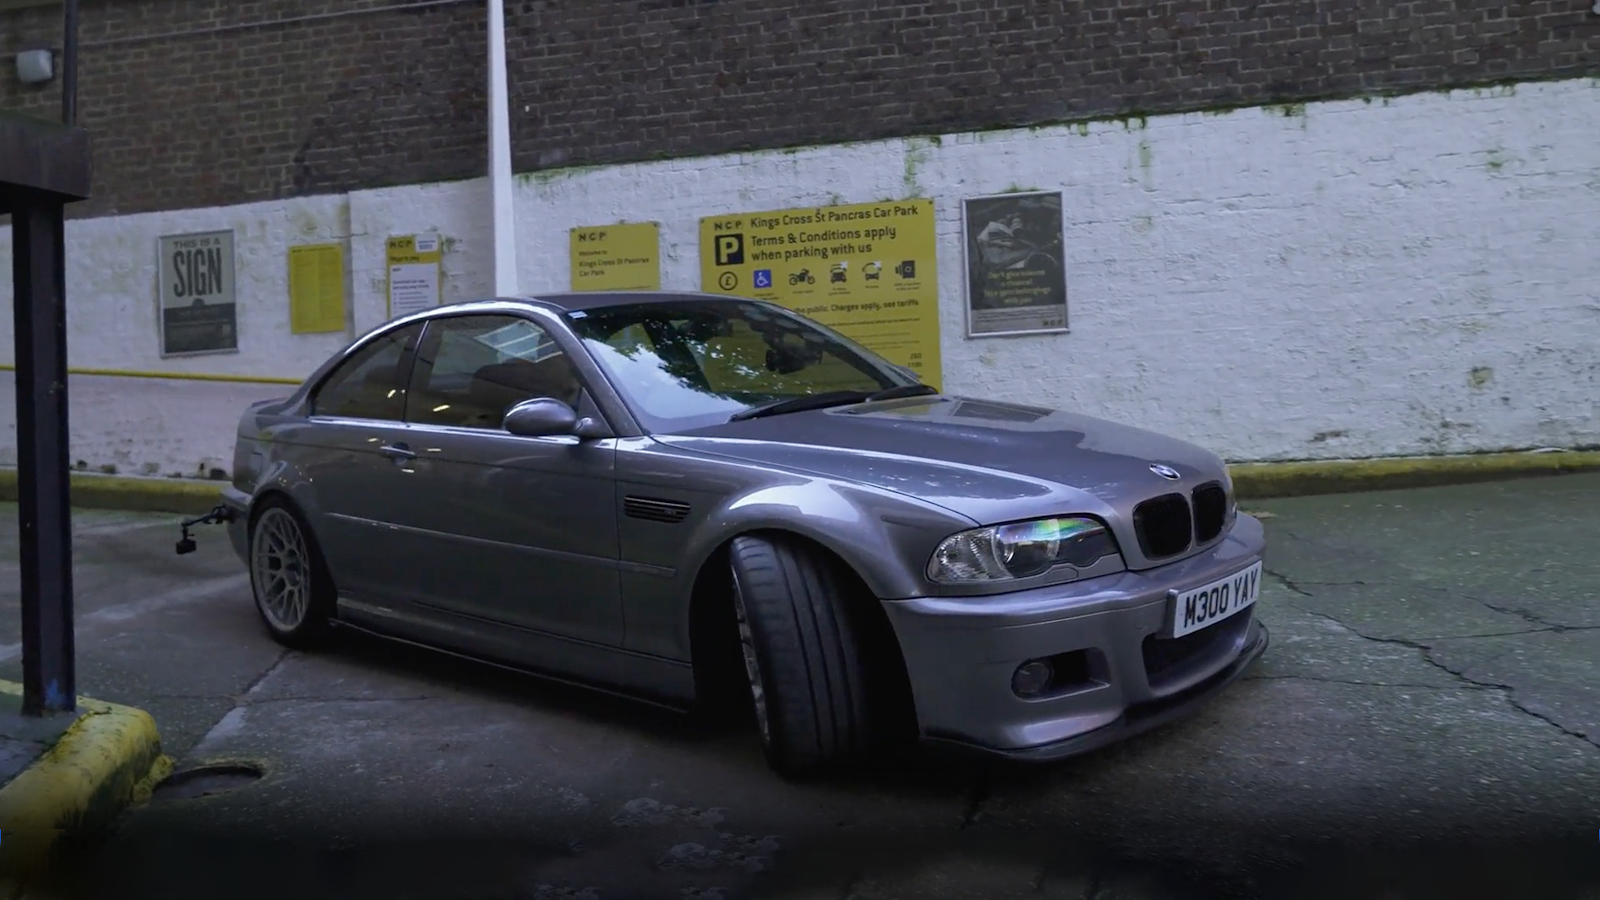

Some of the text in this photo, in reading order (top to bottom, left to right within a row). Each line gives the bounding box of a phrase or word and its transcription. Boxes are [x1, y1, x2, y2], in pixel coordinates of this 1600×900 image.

[750, 205, 918, 230] Kings Cross St Pancras Car Park
[173, 237, 222, 249] THIS IS A
[751, 226, 896, 246] Terms & Conditions apply
[751, 243, 872, 262] when parking with us
[173, 247, 222, 297] SIGN
[579, 261, 597, 269] Kings
[831, 303, 859, 313] Charges
[897, 299, 919, 307] tariffs
[1183, 568, 1259, 628] M300 YAY
